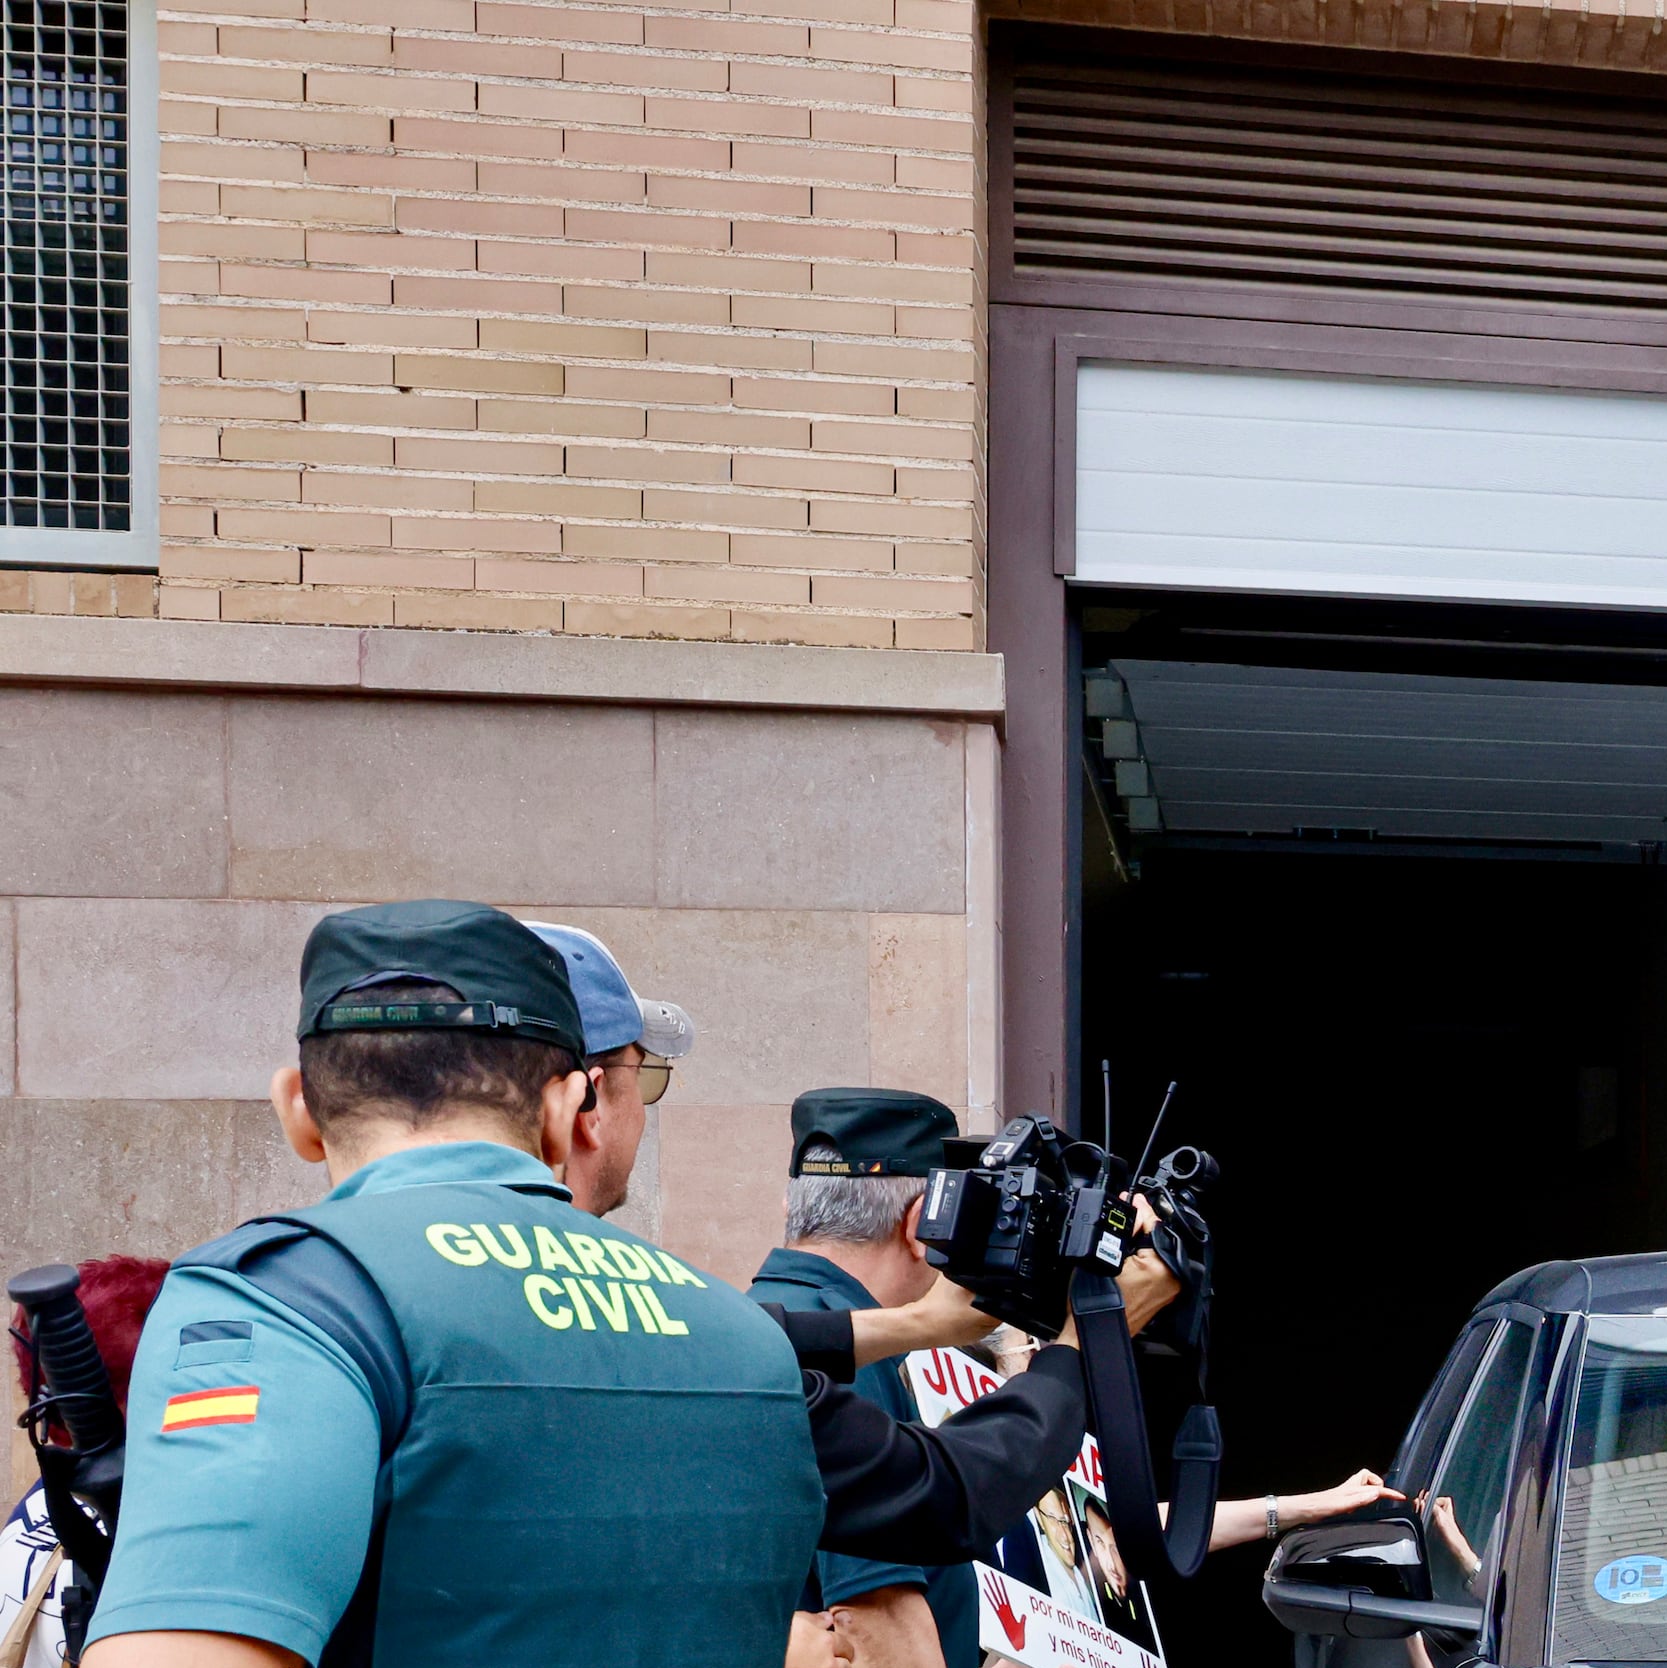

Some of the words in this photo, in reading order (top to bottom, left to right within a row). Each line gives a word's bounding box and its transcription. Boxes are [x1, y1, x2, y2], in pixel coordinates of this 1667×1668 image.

[802, 1162, 831, 1173] GUARDIA
[831, 1163, 851, 1173] CIVIL
[425, 1223, 708, 1289] GUARDIA
[523, 1273, 690, 1336] CIVIL
[1029, 1595, 1053, 1618] por
[1056, 1609, 1075, 1631] mi
[1077, 1620, 1122, 1655] marido
[1048, 1632, 1057, 1653] y
[1060, 1639, 1086, 1663] mis
